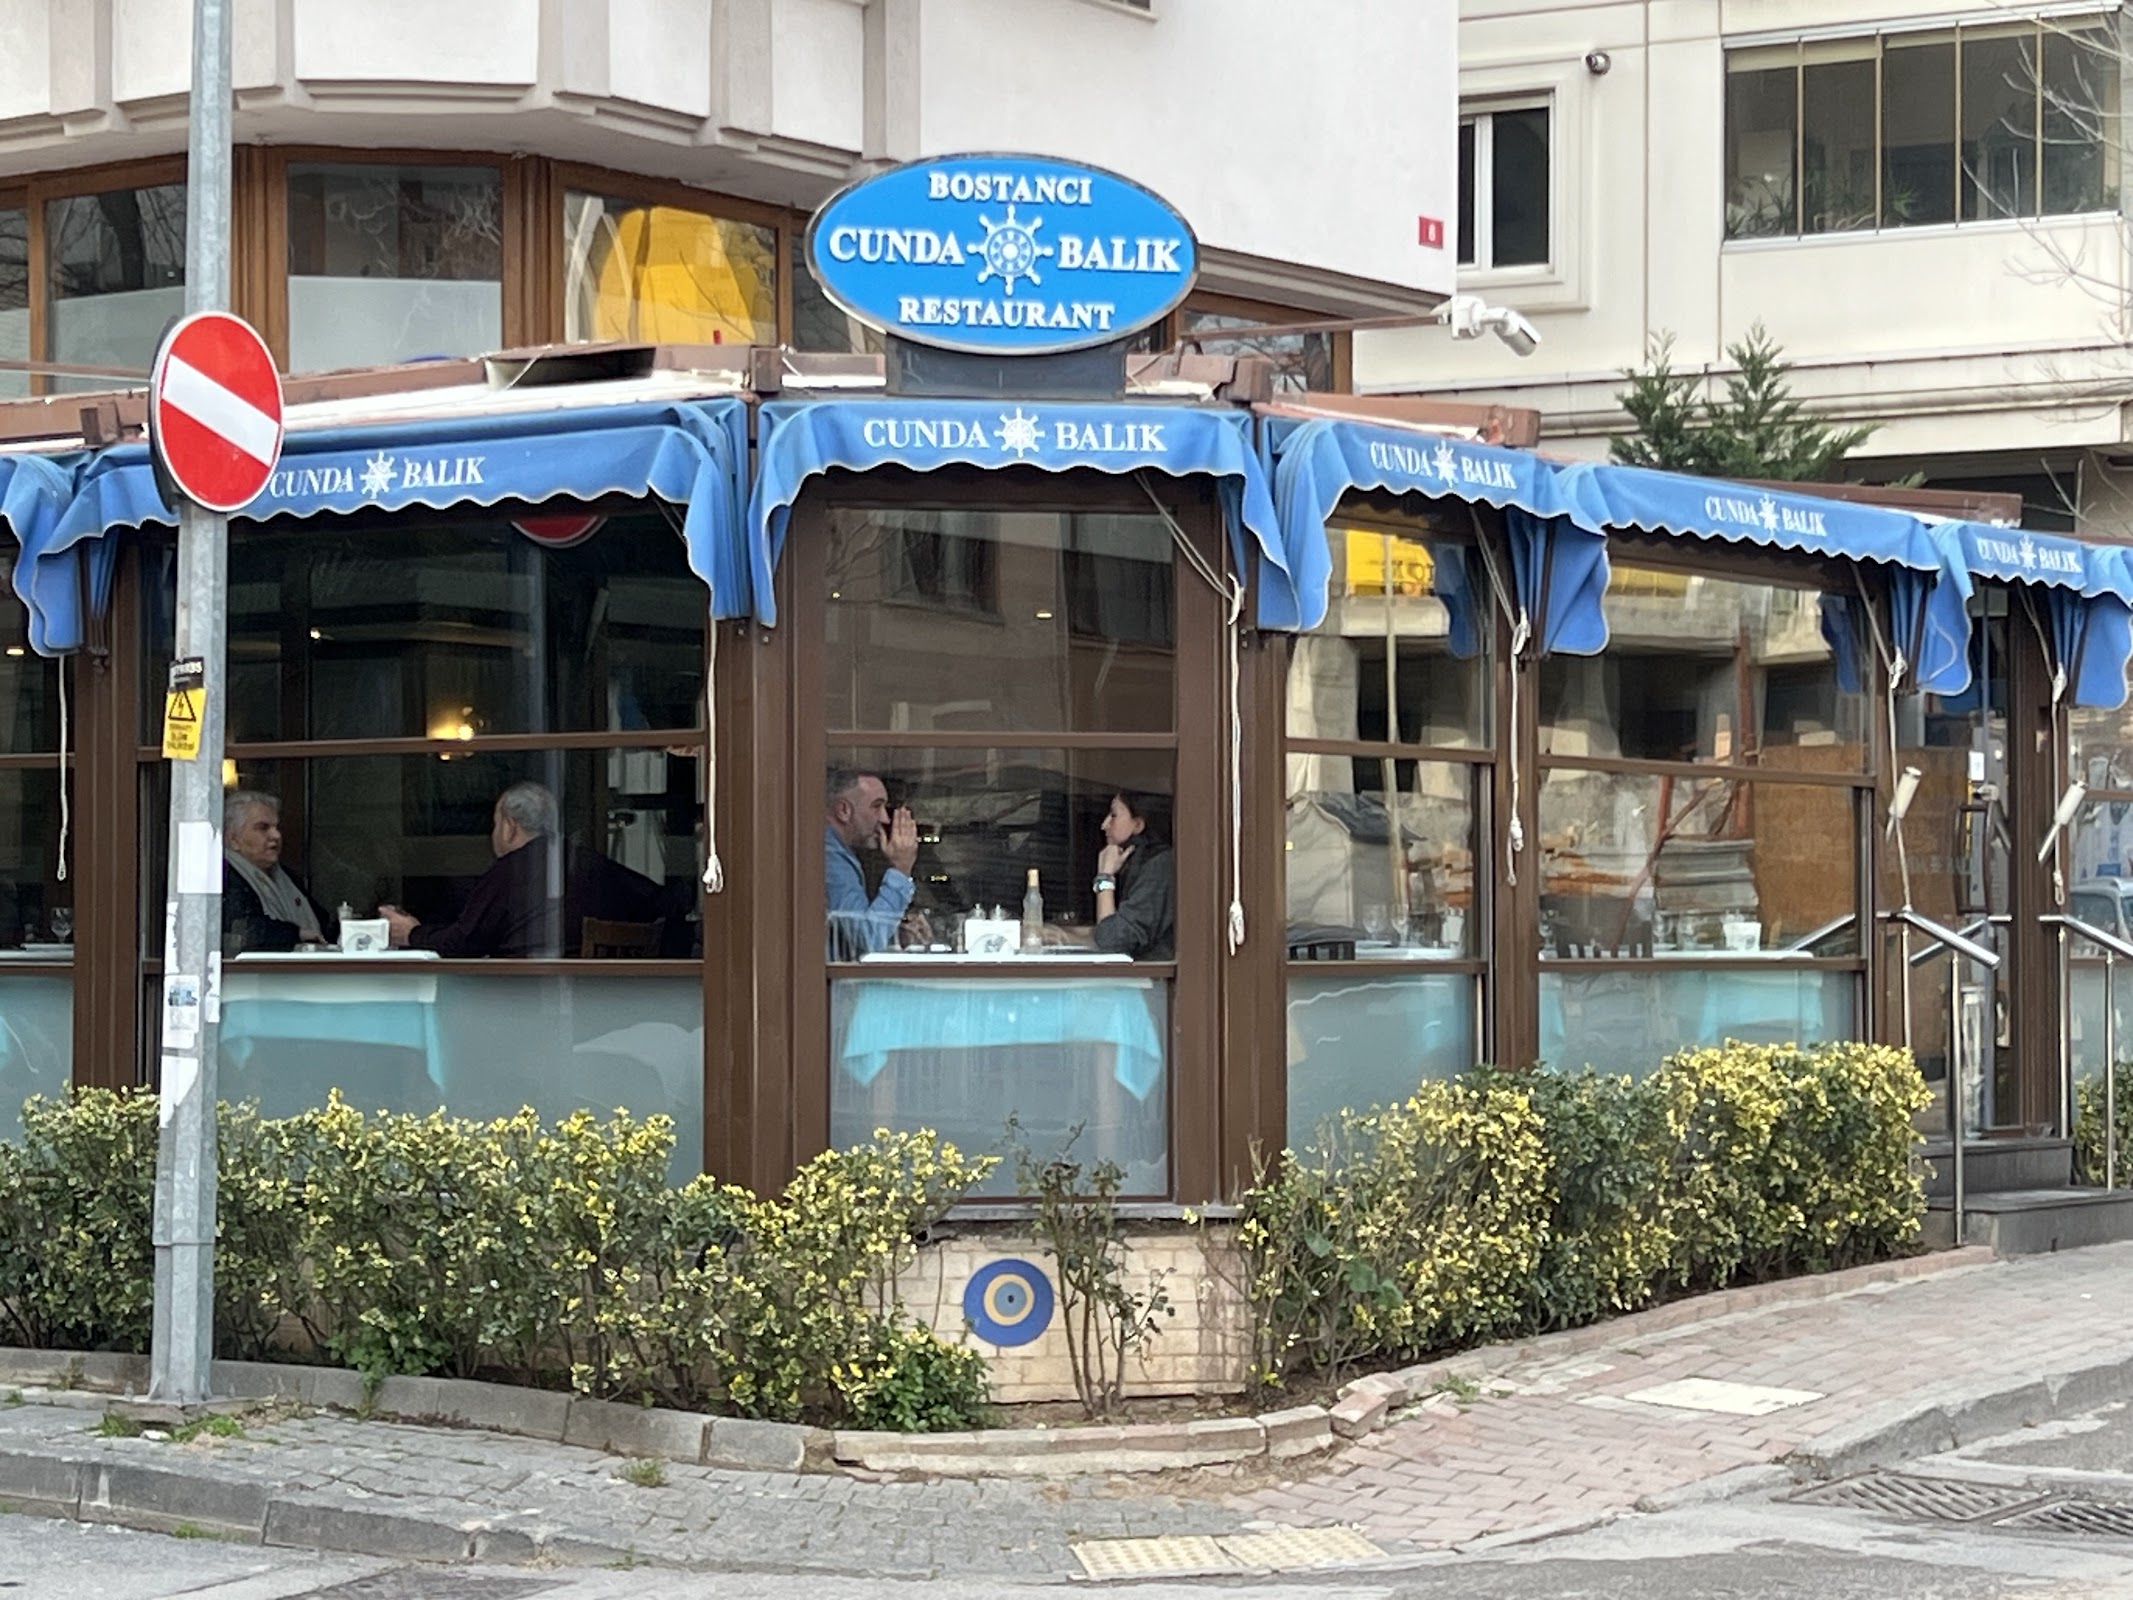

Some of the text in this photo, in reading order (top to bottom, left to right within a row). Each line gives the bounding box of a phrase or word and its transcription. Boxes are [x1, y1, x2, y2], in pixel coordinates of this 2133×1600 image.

[928, 172, 1092, 204] BOSTANCI
[829, 227, 1182, 273] CUNDA BALIK
[898, 297, 1115, 330] RESTAURANT
[863, 419, 1168, 452] CUNDA BALIK
[270, 456, 486, 498] CUNDA BALIK
[1370, 441, 1518, 490] CUNDA BALIK
[1705, 496, 1828, 537] CUNDA BALIK
[2039, 547, 2083, 573] BALIK
